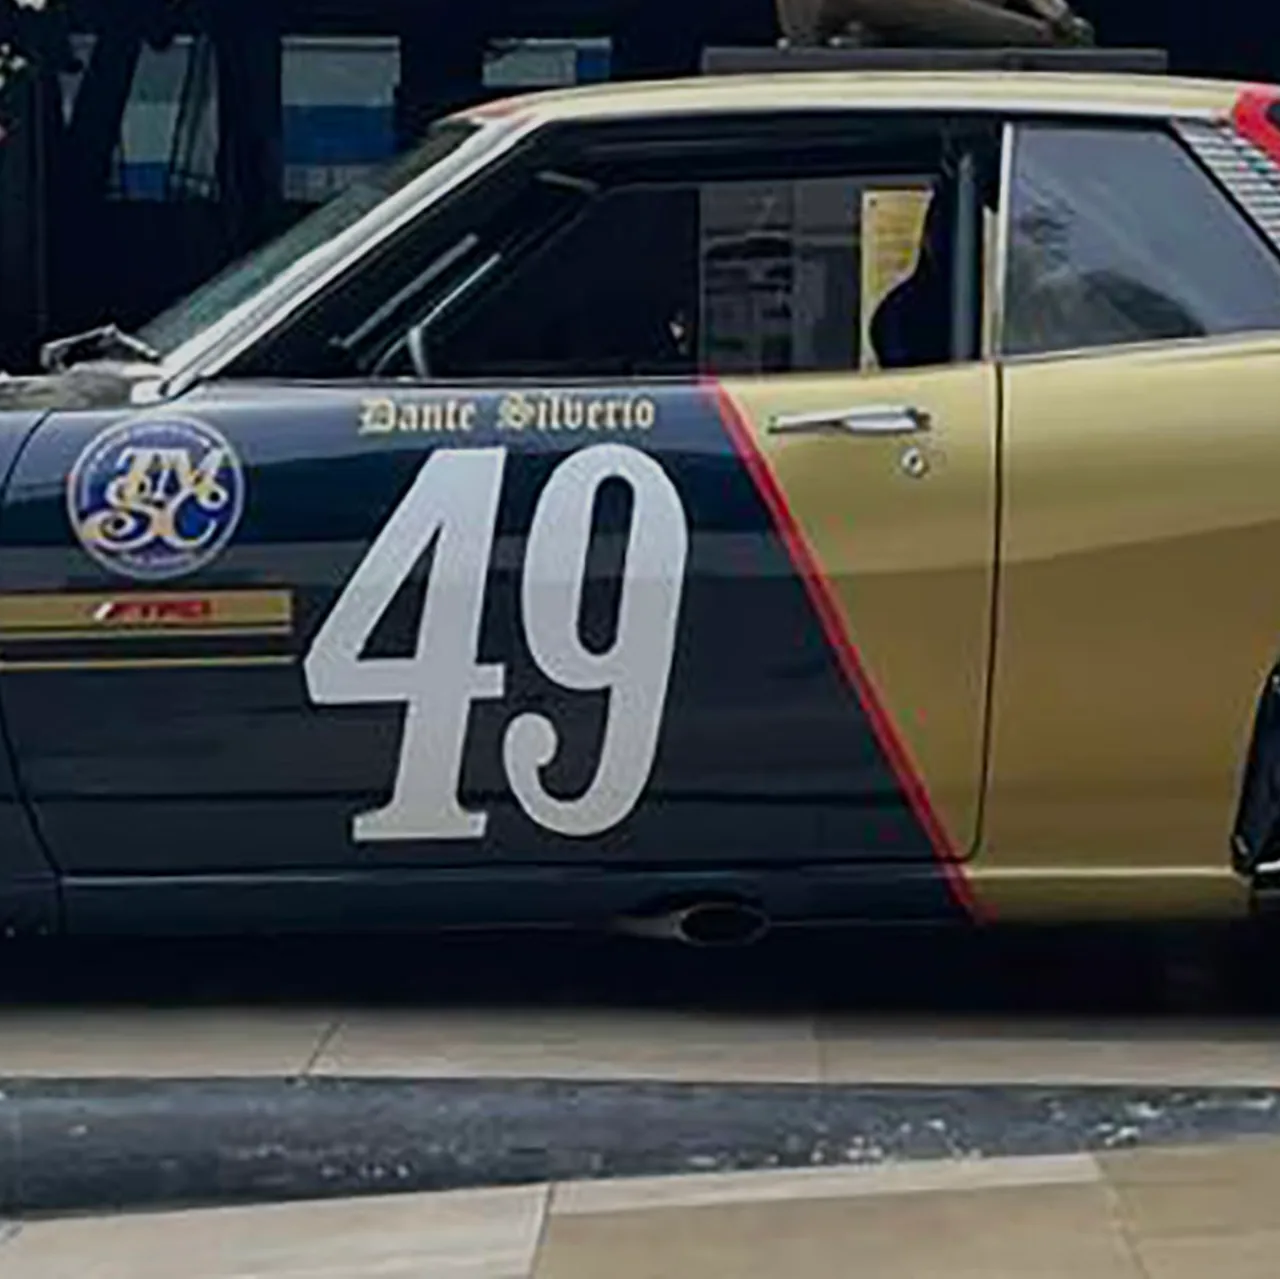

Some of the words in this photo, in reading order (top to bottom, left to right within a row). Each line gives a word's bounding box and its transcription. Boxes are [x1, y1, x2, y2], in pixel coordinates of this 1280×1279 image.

[359, 395, 476, 435] Dante
[497, 391, 656, 430] Silverio
[305, 443, 688, 840] 49
